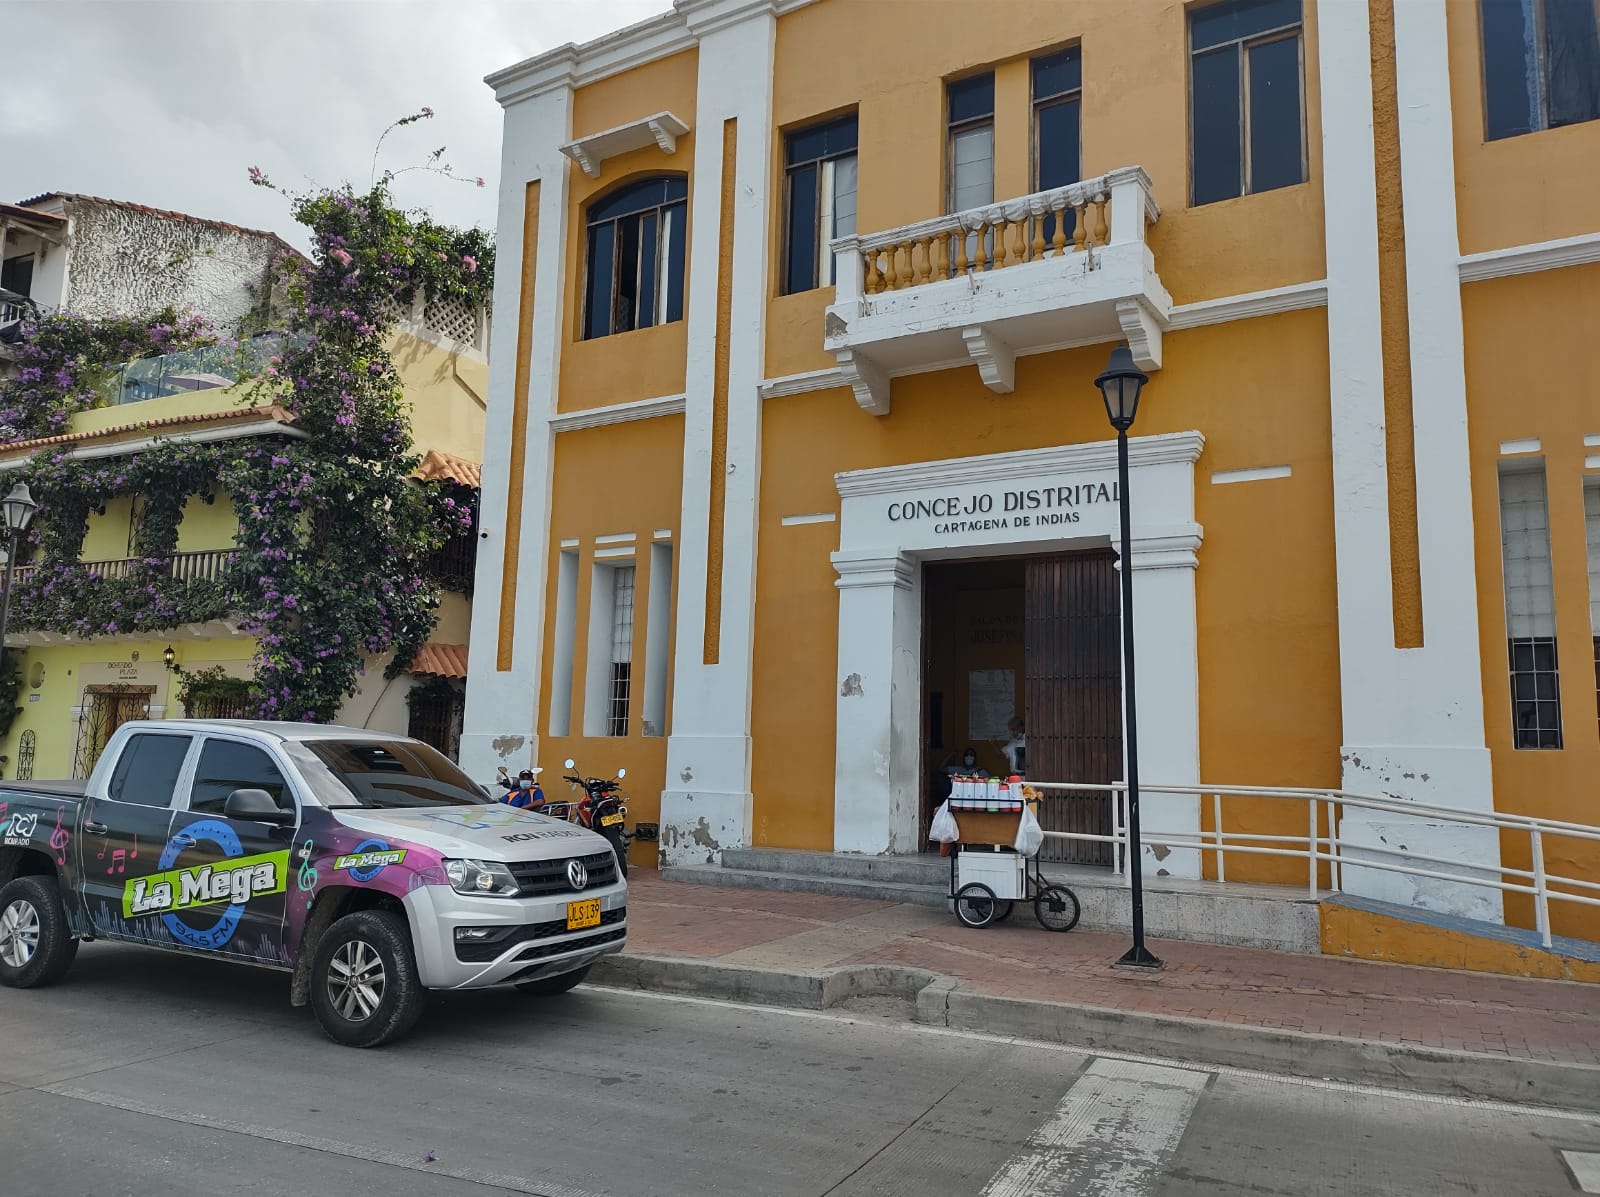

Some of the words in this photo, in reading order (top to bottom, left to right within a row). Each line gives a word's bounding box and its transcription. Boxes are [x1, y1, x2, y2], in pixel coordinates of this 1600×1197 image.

[887, 493, 993, 521] CONCEJO
[1003, 481, 1120, 512] DISTRITAL
[934, 518, 1008, 534] CARTAGENA
[1014, 516, 1031, 527] DE
[1036, 512, 1080, 526] INDIAS
[500, 832, 540, 843] RCN
[339, 856, 357, 868] La
[360, 853, 400, 866] Mega
[131, 879, 173, 913] La
[178, 862, 277, 905] Mega
[174, 922, 210, 947] 94.5
[211, 917, 233, 945] FM
